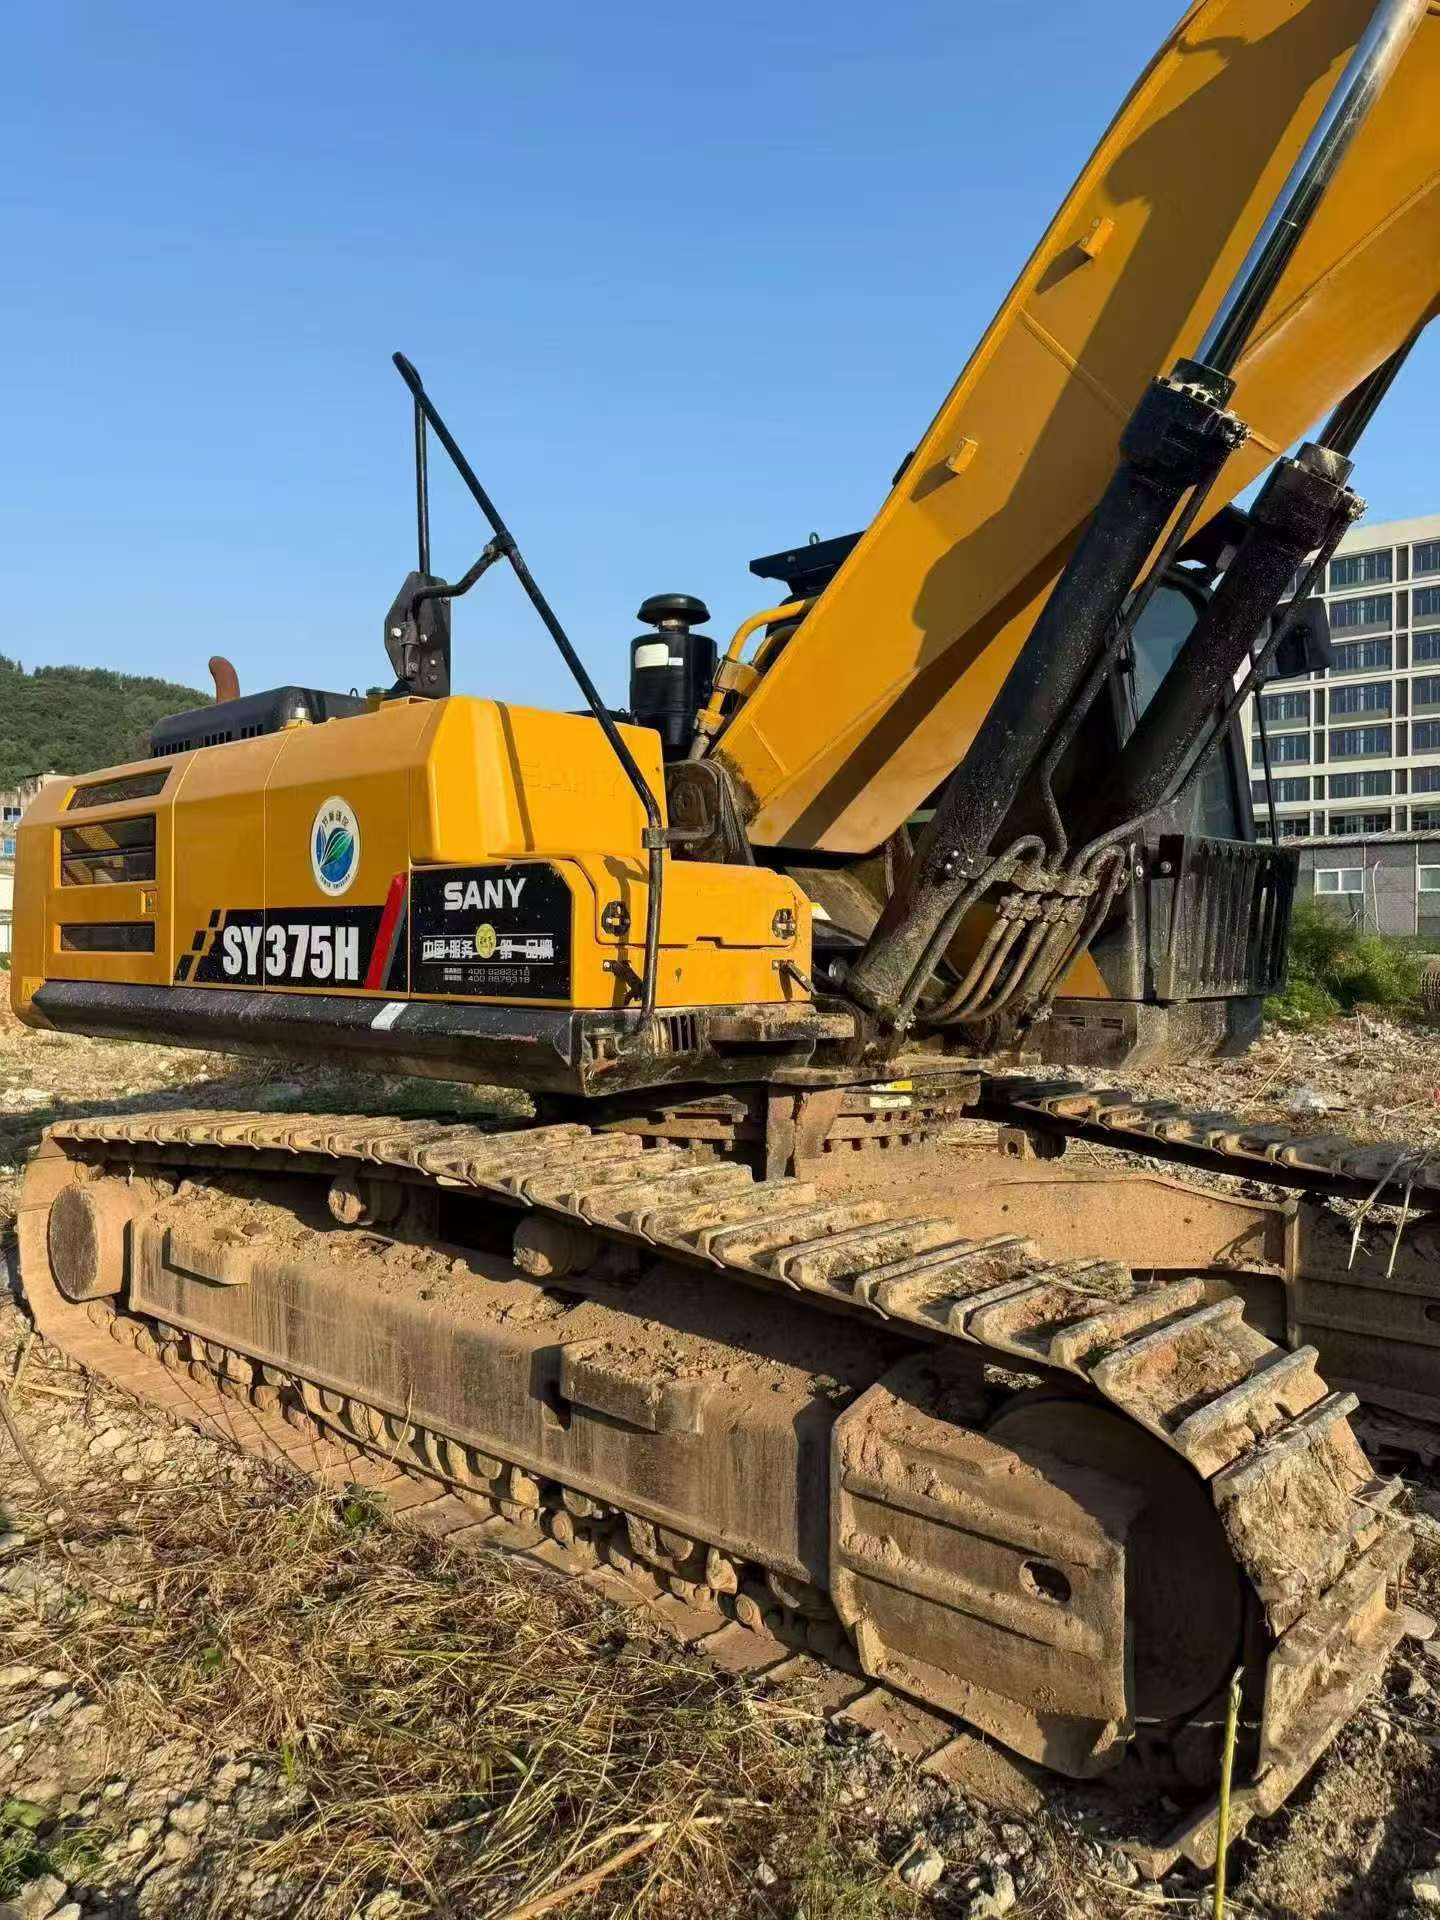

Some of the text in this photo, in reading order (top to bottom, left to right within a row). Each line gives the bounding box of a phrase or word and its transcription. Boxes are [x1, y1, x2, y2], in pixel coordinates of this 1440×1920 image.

[444, 878, 526, 910] SANY
[223, 924, 359, 981] SY375H
[467, 975, 486, 983] 400
